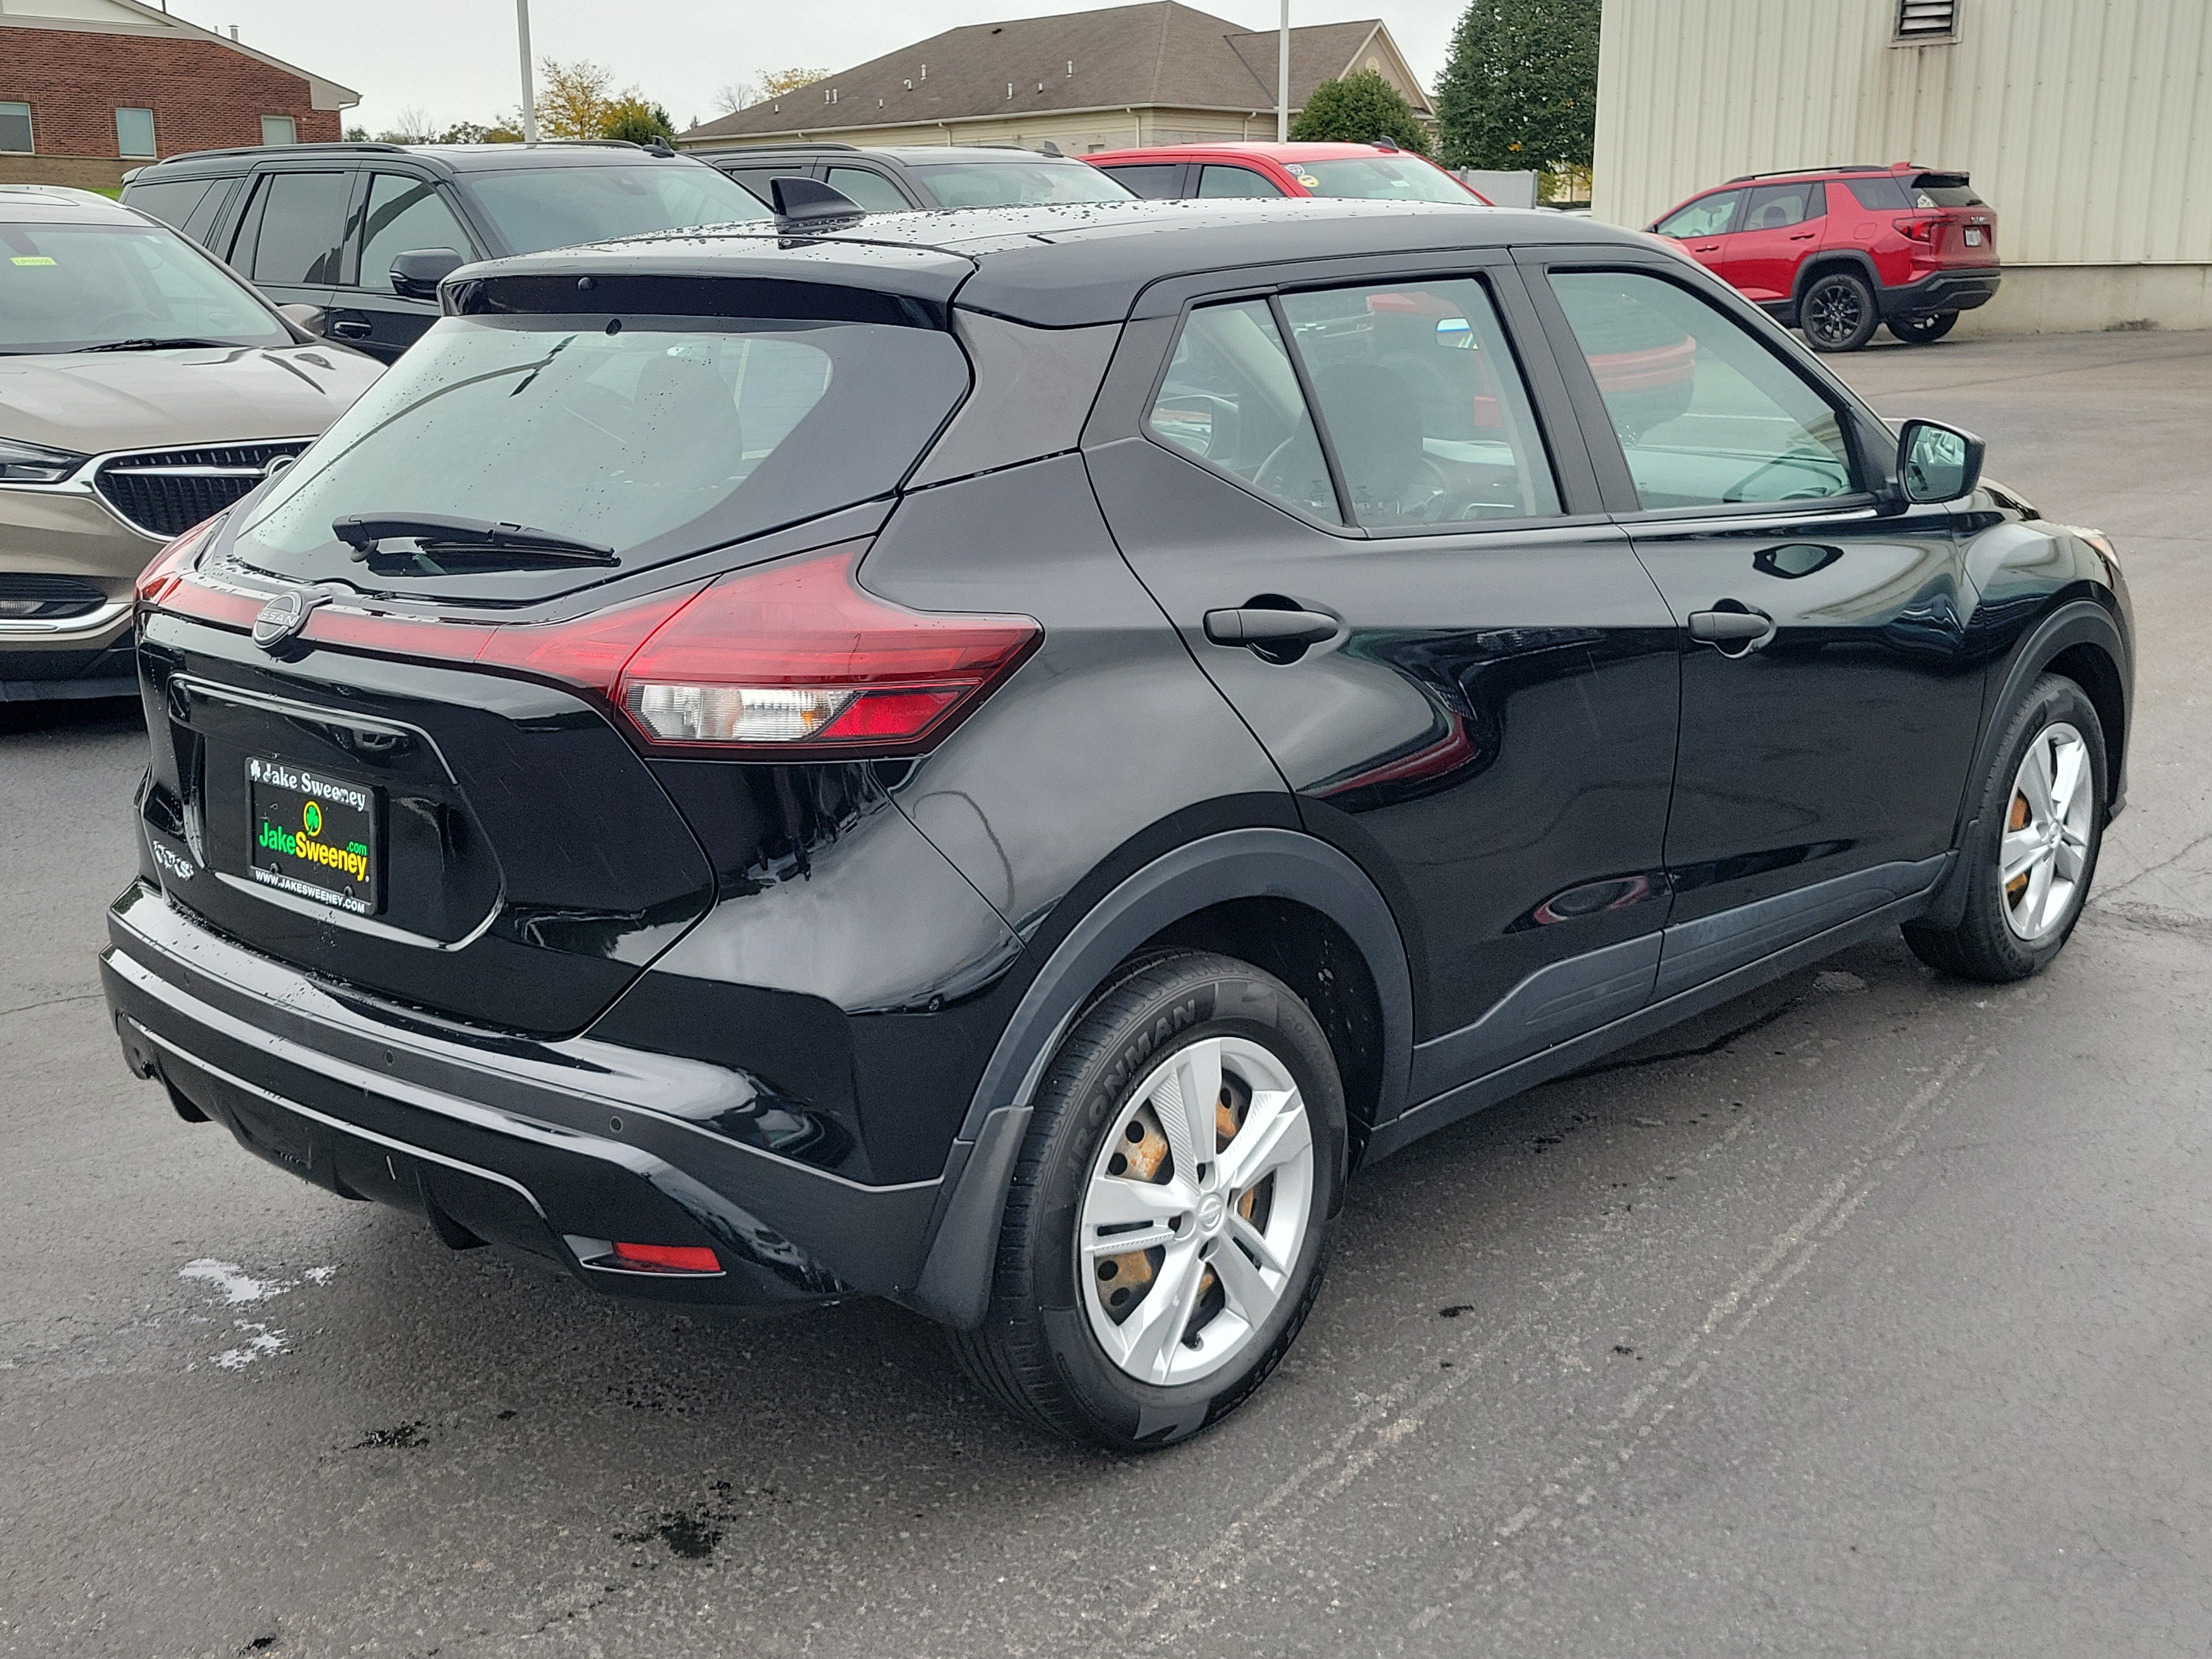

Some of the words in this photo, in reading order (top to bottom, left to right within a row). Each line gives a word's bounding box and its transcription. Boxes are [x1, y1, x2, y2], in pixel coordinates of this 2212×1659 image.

[262, 763, 298, 789] Jake
[301, 772, 366, 811] Sweeney
[255, 870, 365, 913] WWW.JAKESWEENEY.COM
